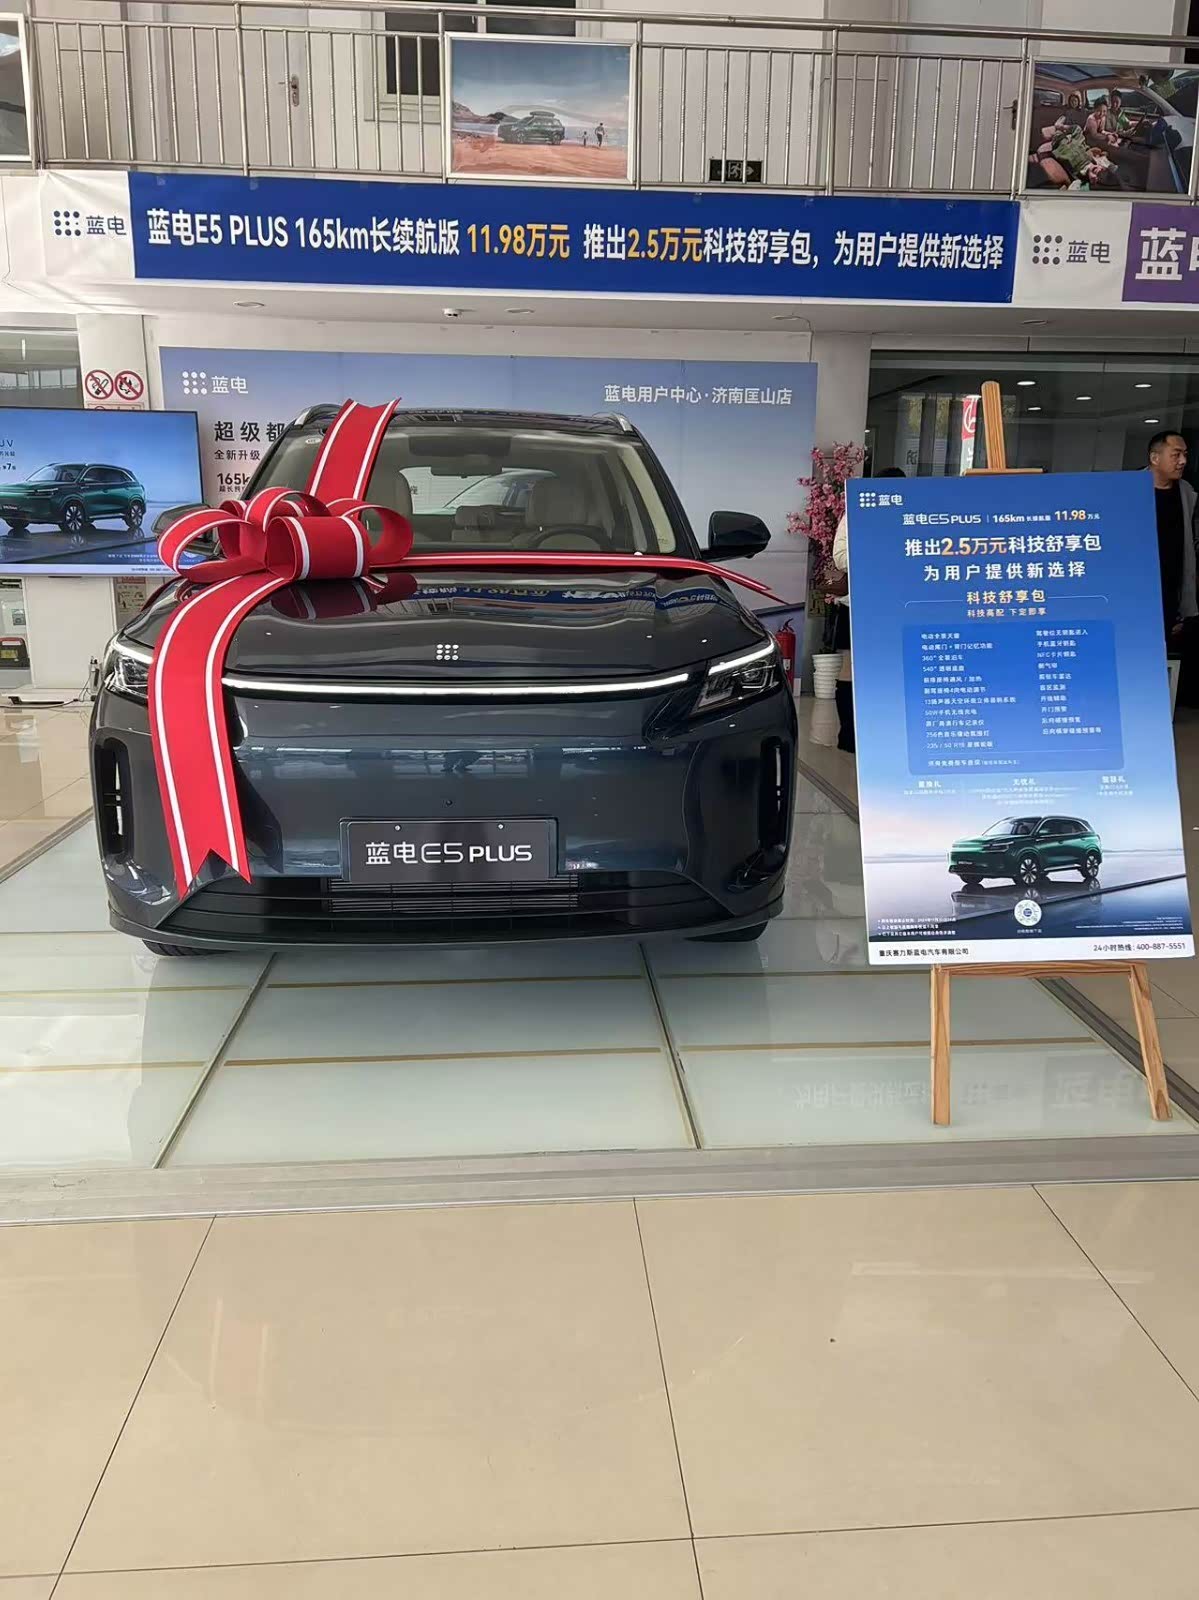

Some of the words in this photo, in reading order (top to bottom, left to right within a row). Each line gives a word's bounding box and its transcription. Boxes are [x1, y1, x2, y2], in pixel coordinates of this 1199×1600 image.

[86, 213, 127, 238] 蓝电
[146, 207, 223, 247] 蓝电E5
[230, 215, 289, 249] PLUS
[295, 216, 460, 256] 165km长续航版
[467, 223, 570, 258] 11.98万元
[1066, 239, 1111, 265] 蓝电
[1135, 226, 1199, 282] 蓝
[211, 375, 248, 395] 蓝电
[604, 384, 793, 405] 蓝电用户中心·济南匡山店
[214, 449, 261, 461] 全新升级
[878, 493, 903, 506] 蓝电
[951, 513, 981, 525] PLUS
[904, 533, 1102, 557] 推出2.5万元科技舒享包
[924, 561, 1087, 582] 为用户提供新选择
[966, 590, 1046, 605] 科技舒享包
[469, 844, 533, 863] PLUS
